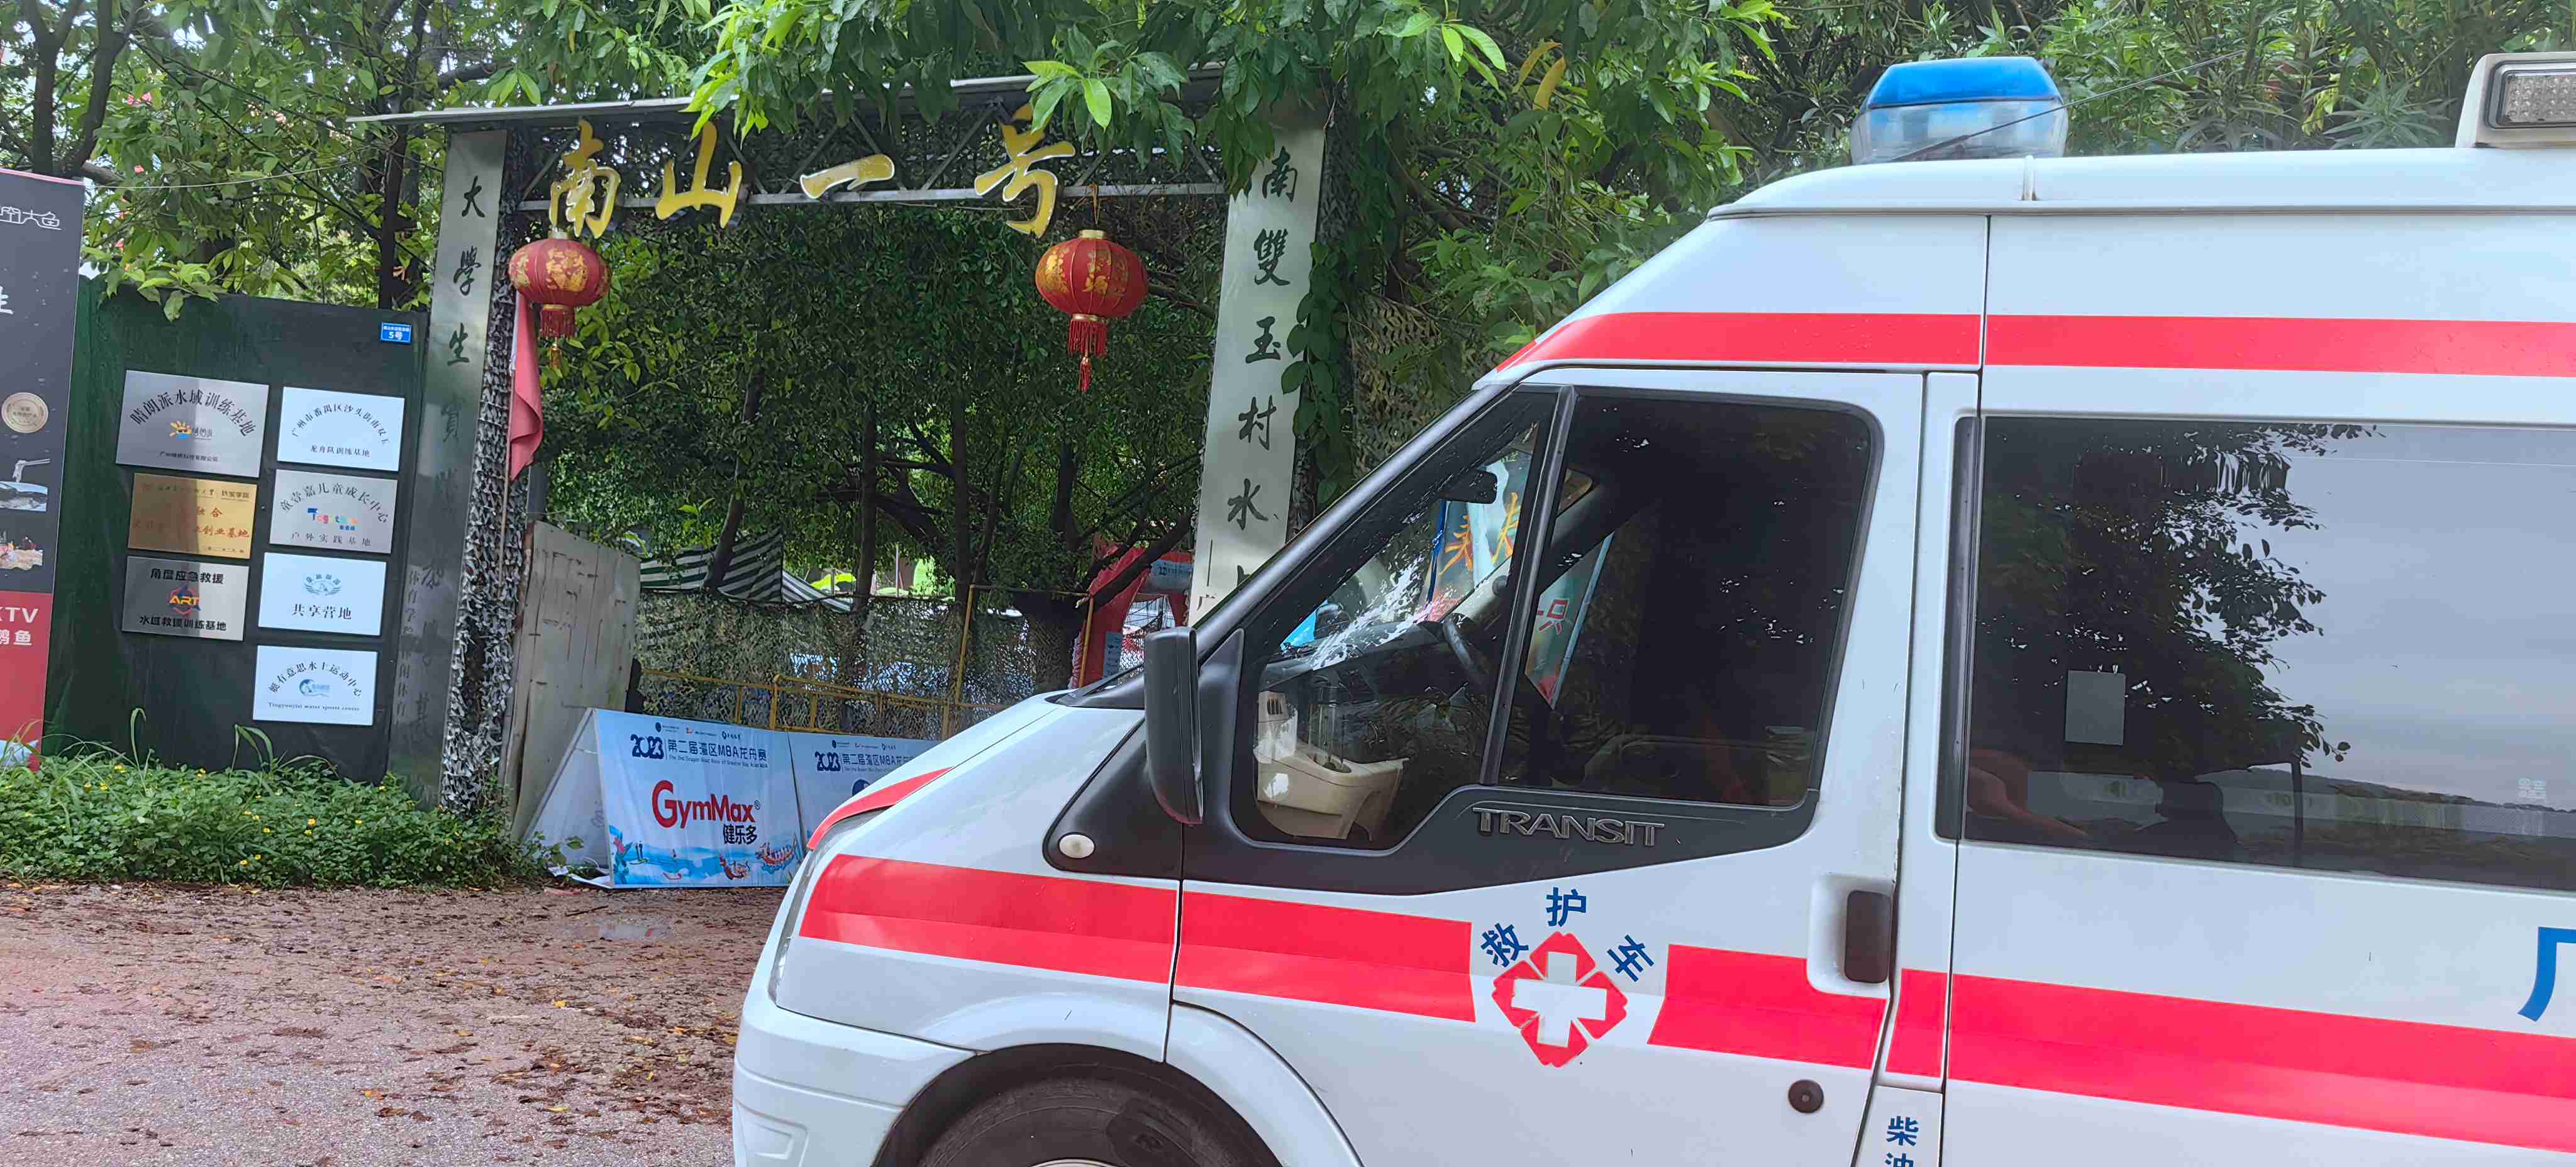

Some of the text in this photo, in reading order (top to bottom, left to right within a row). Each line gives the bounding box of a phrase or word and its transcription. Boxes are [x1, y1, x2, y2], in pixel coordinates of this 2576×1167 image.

[548, 103, 1076, 238] 南山一号
[1226, 146, 1299, 590] 南雙玉村水
[130, 389, 255, 437] 晴朗派水域训练基地
[150, 568, 224, 584] 角度应急救援
[170, 595, 200, 606] ART
[292, 603, 352, 619] 共享营地
[0, 606, 38, 624] TV
[139, 615, 227, 631] 水域救援训练基地
[630, 734, 664, 760] 2023
[814, 751, 841, 772] 2023
[723, 824, 758, 845] 健乐多
[1472, 807, 1665, 846] TRANSIT
[1480, 887, 1655, 983] 救护车
